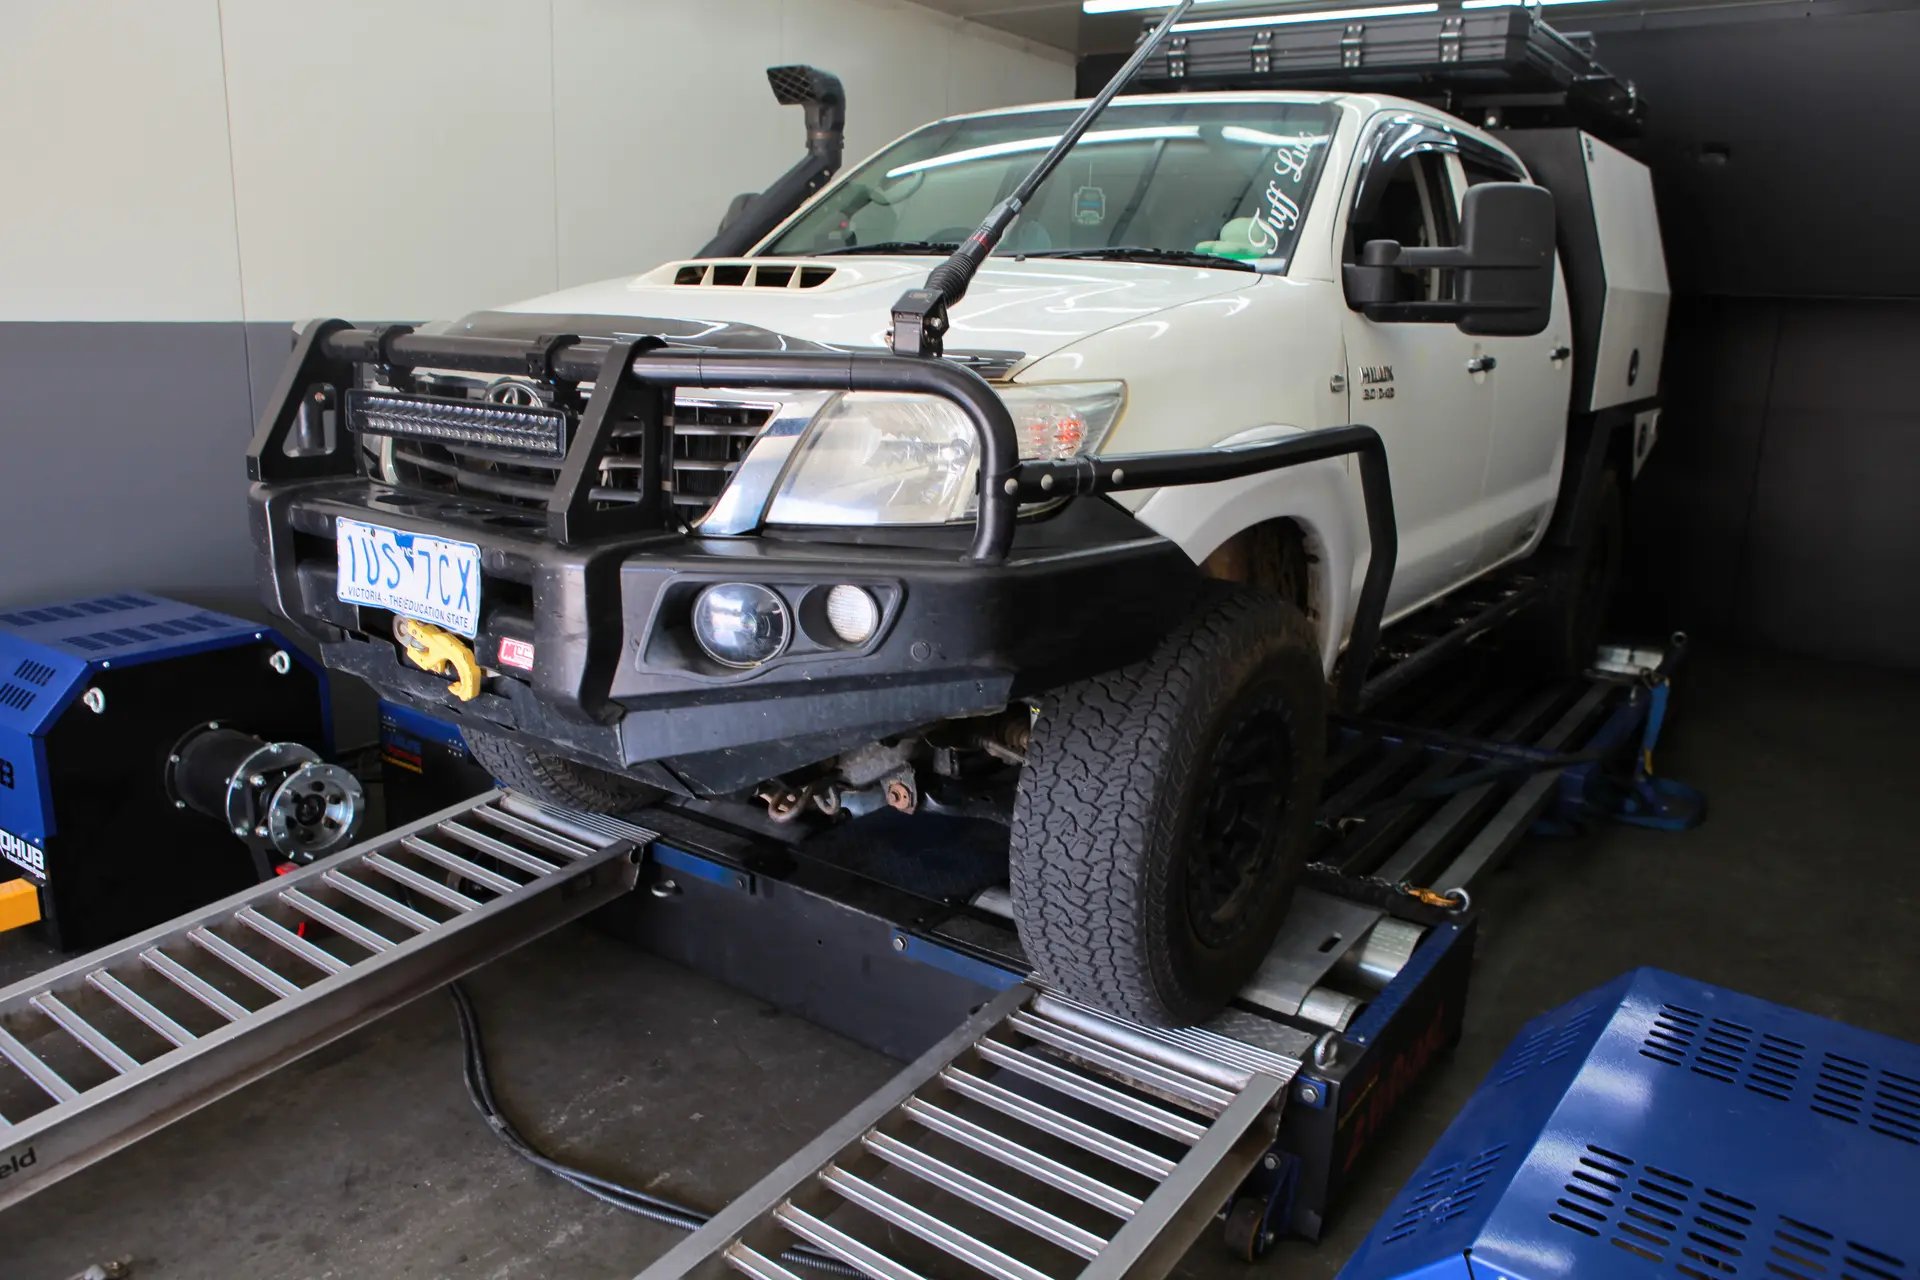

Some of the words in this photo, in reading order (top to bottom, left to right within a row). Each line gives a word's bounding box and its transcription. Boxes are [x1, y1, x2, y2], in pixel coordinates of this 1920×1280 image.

[1248, 180, 1300, 255] Tuff
[347, 534, 402, 590] 1US
[417, 550, 472, 614] 7CX
[347, 586, 382, 602] VICTORIA
[389, 594, 403, 608] THE
[403, 598, 445, 622] EDUCATION
[446, 612, 469, 629] STATE
